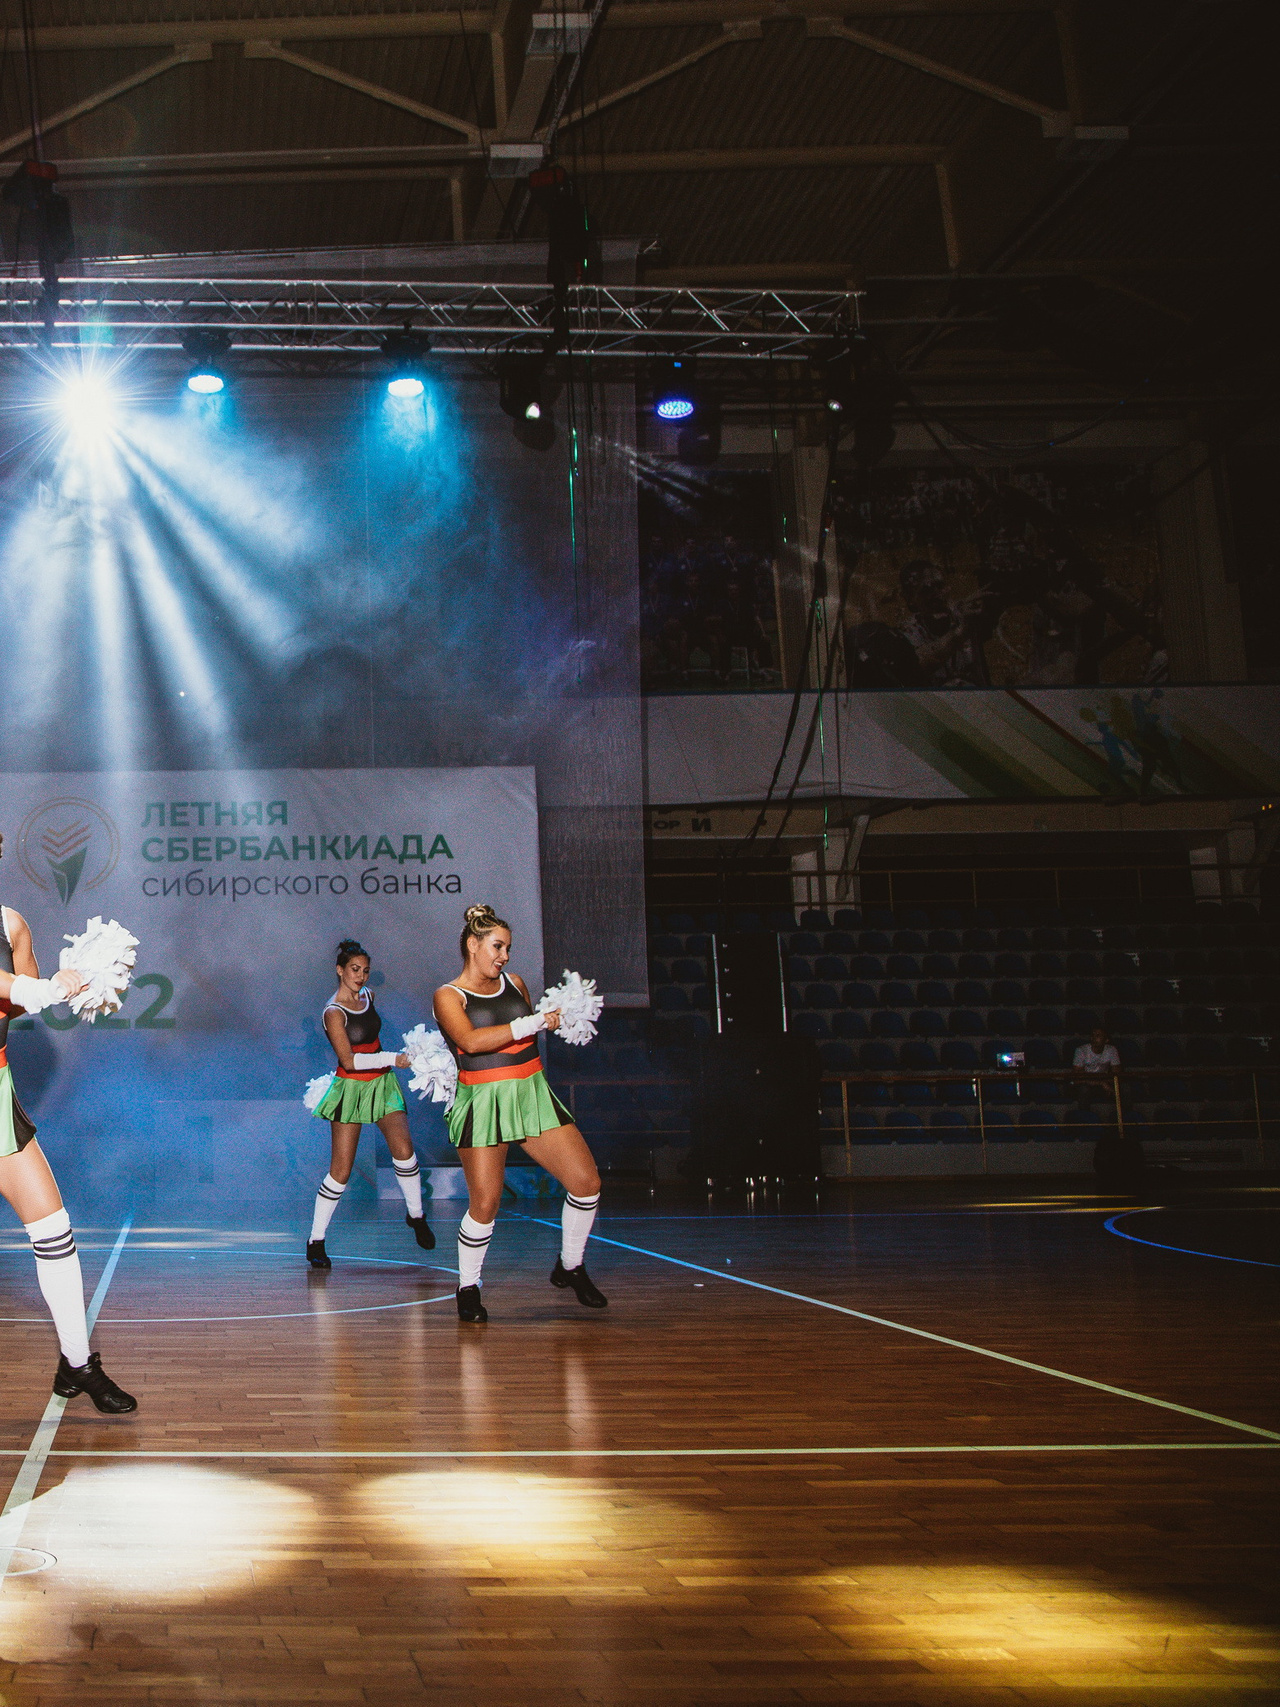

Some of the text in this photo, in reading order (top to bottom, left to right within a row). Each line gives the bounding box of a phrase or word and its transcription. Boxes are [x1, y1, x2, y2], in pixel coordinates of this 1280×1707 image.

[141, 800, 288, 827] ЛЕТНЯЯ
[141, 834, 454, 864] СБЕРБАНКИАДА
[142, 867, 462, 902] сибирского банка
